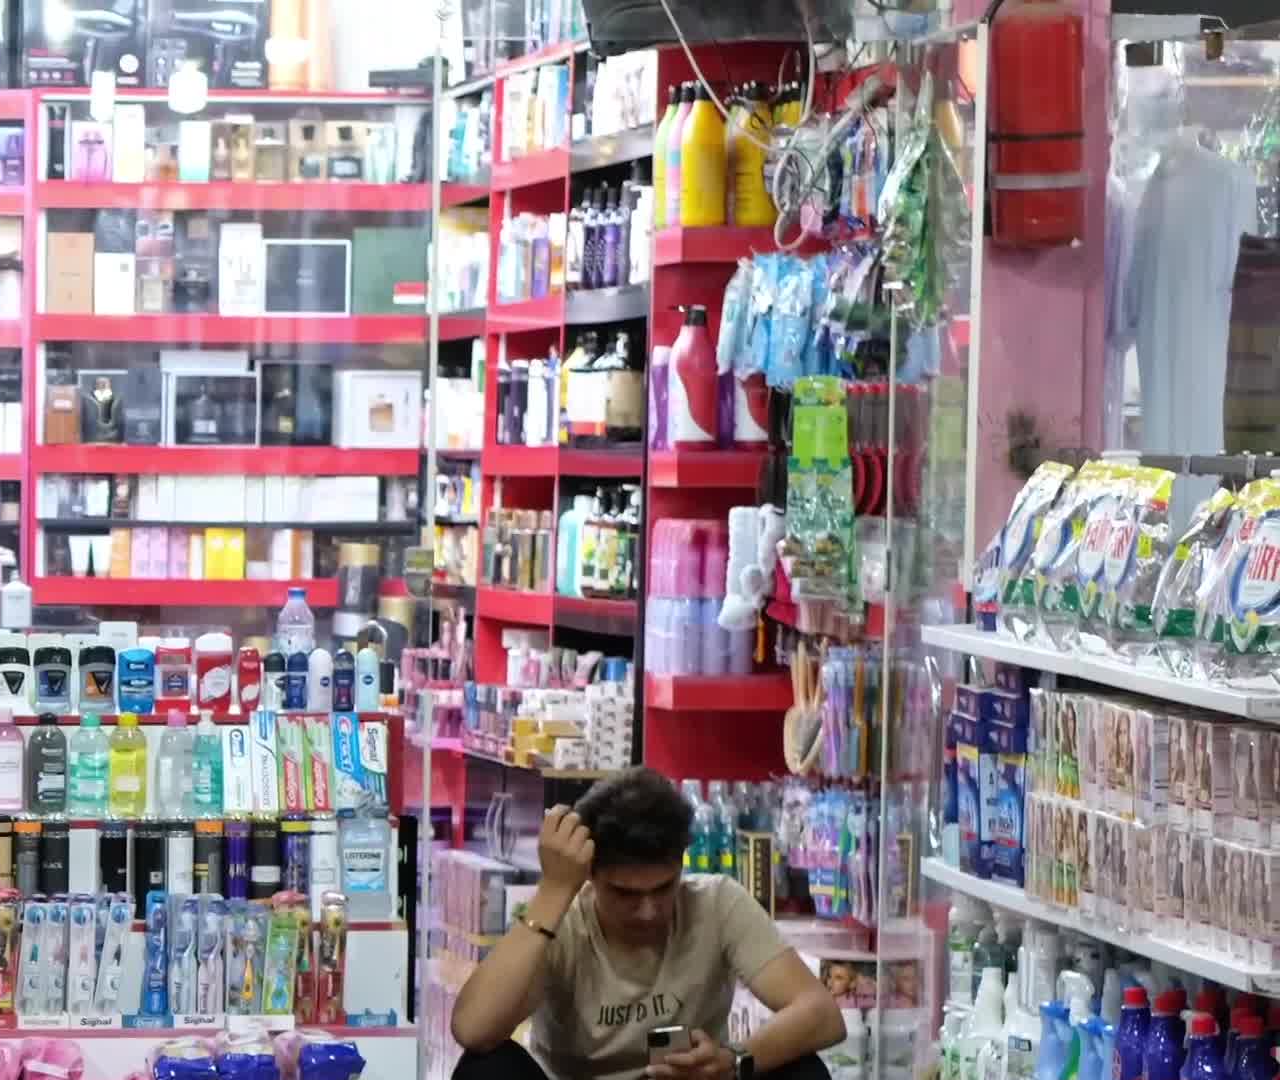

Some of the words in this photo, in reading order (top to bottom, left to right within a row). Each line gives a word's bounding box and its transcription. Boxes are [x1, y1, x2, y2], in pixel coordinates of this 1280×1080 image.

[344, 852, 382, 860] LISTERINE
[80, 1017, 113, 1027] Signal
[184, 1016, 216, 1025] Signal
